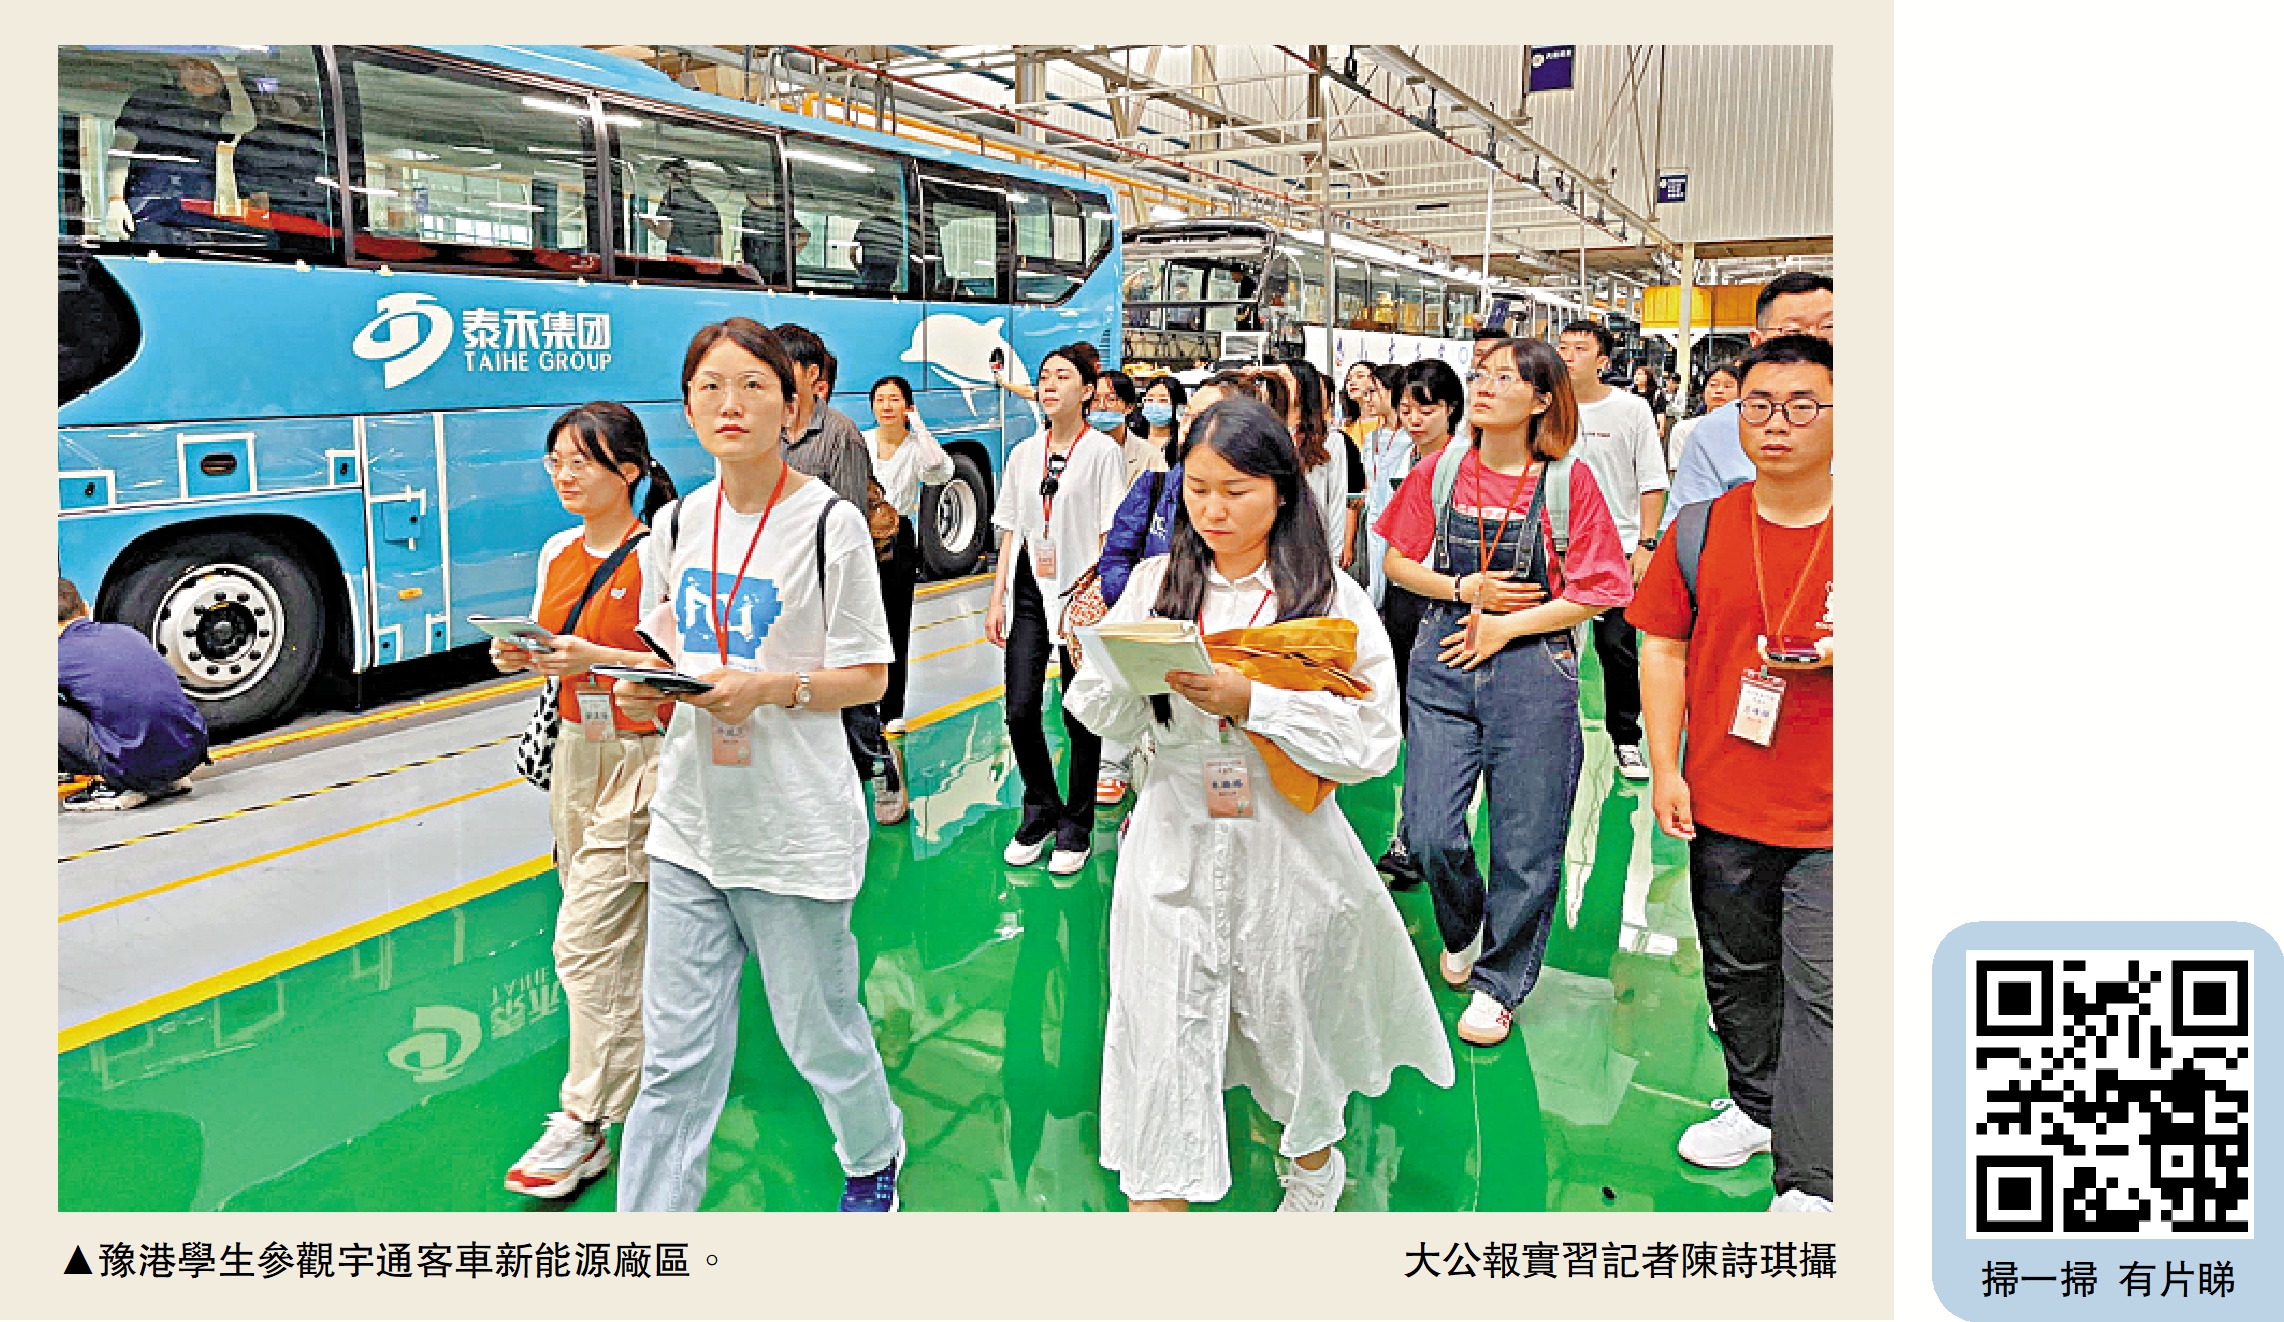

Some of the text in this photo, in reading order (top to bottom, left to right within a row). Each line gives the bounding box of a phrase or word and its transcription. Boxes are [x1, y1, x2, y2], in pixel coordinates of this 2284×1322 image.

[462, 307, 611, 350] 泰禾集团
[464, 350, 612, 372] TAIHE GROUP
